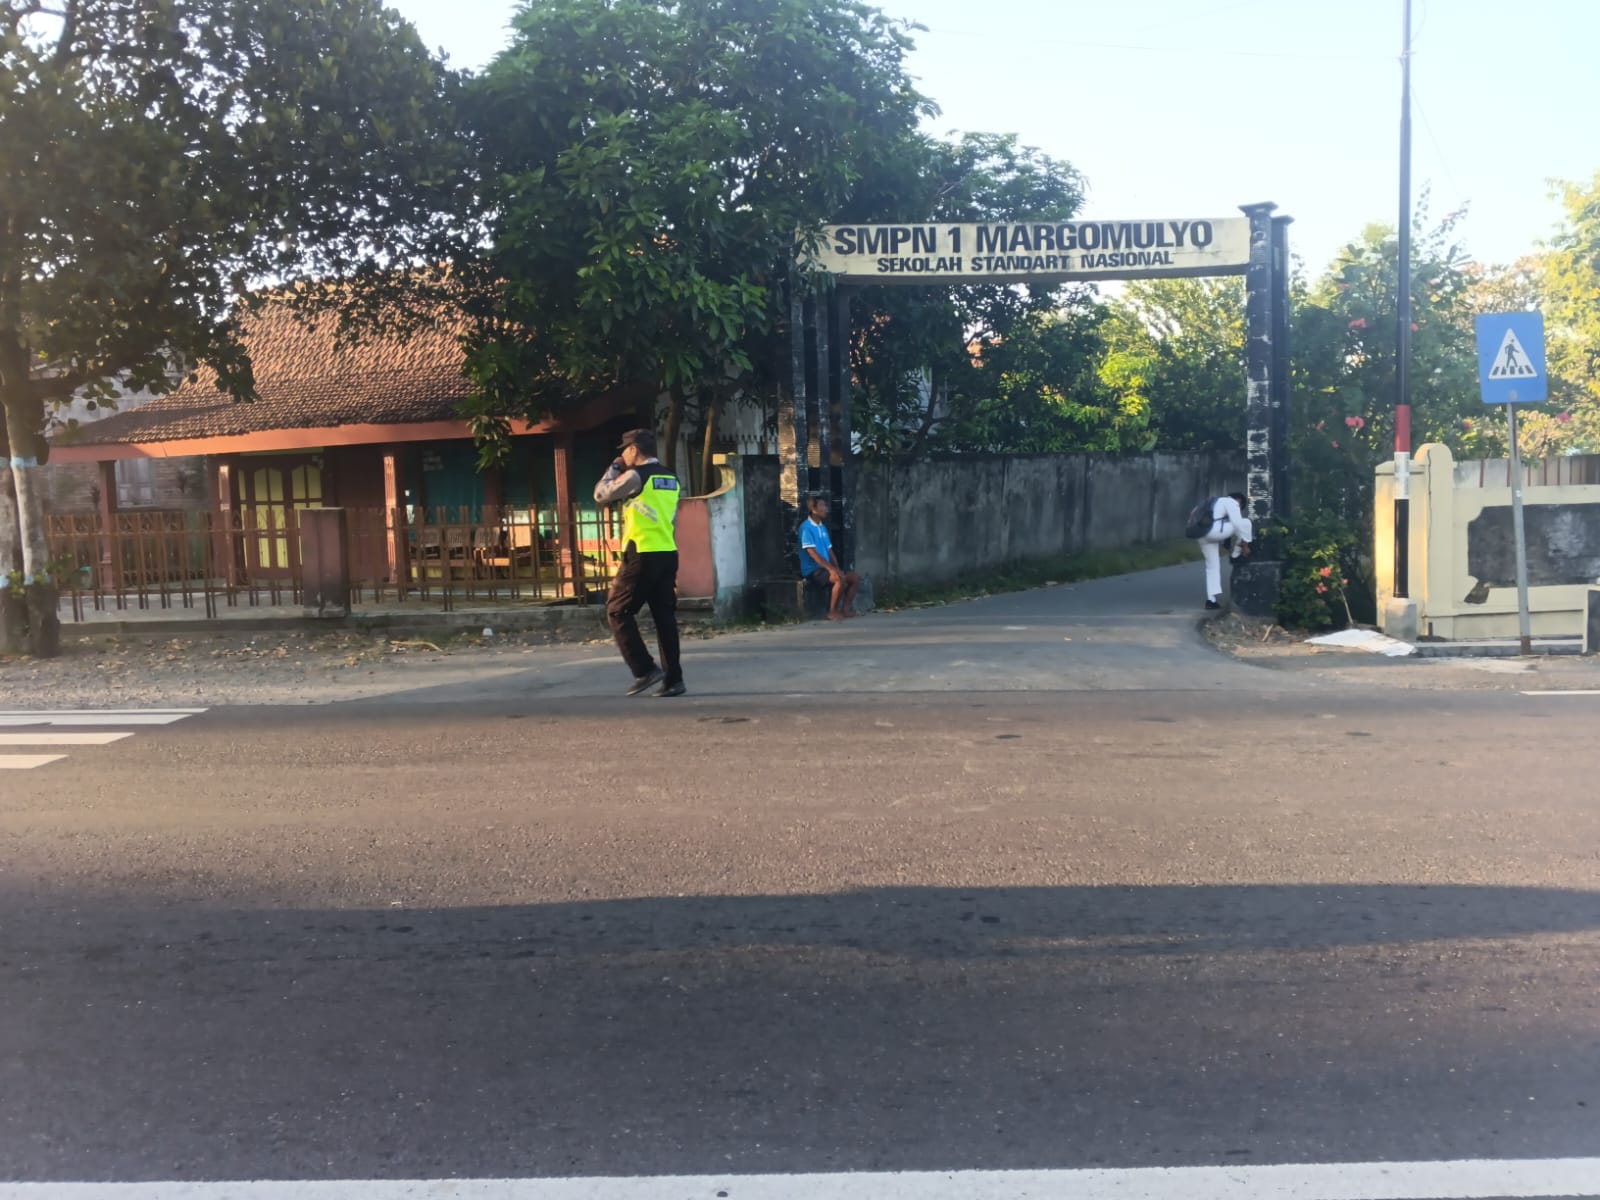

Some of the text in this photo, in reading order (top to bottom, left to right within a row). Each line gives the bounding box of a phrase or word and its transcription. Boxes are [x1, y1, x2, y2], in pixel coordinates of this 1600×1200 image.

[834, 220, 1213, 255] SMPN 1 MARGOMULYO
[877, 251, 1174, 272] SEKOLAH STANDART NASIONAL
